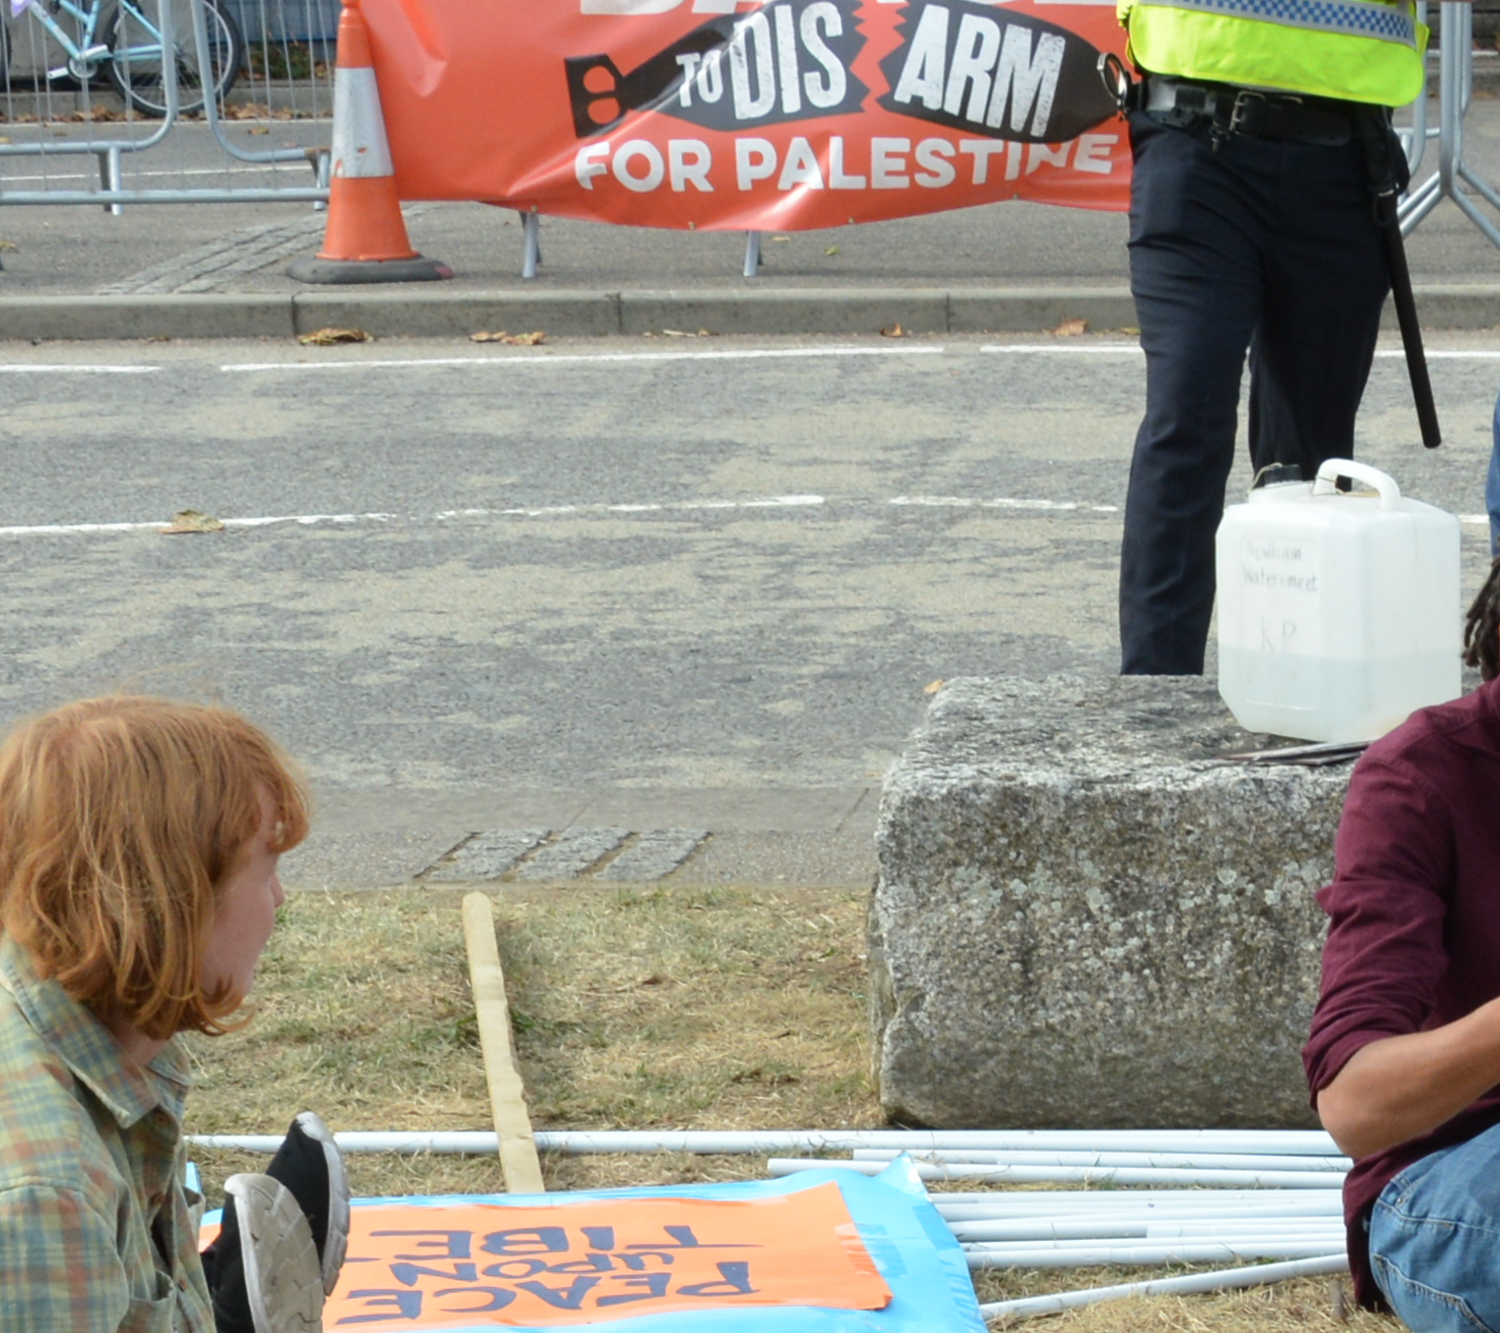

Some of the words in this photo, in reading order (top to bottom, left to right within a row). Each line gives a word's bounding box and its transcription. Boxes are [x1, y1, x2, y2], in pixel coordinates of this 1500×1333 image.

[676, 52, 725, 107] TO
[730, 2, 847, 120] DIS
[893, 3, 1067, 138] ARM
[574, 138, 714, 192] FOR
[736, 133, 1119, 191] PALESTINE
[334, 1260, 762, 1326] PEACE
